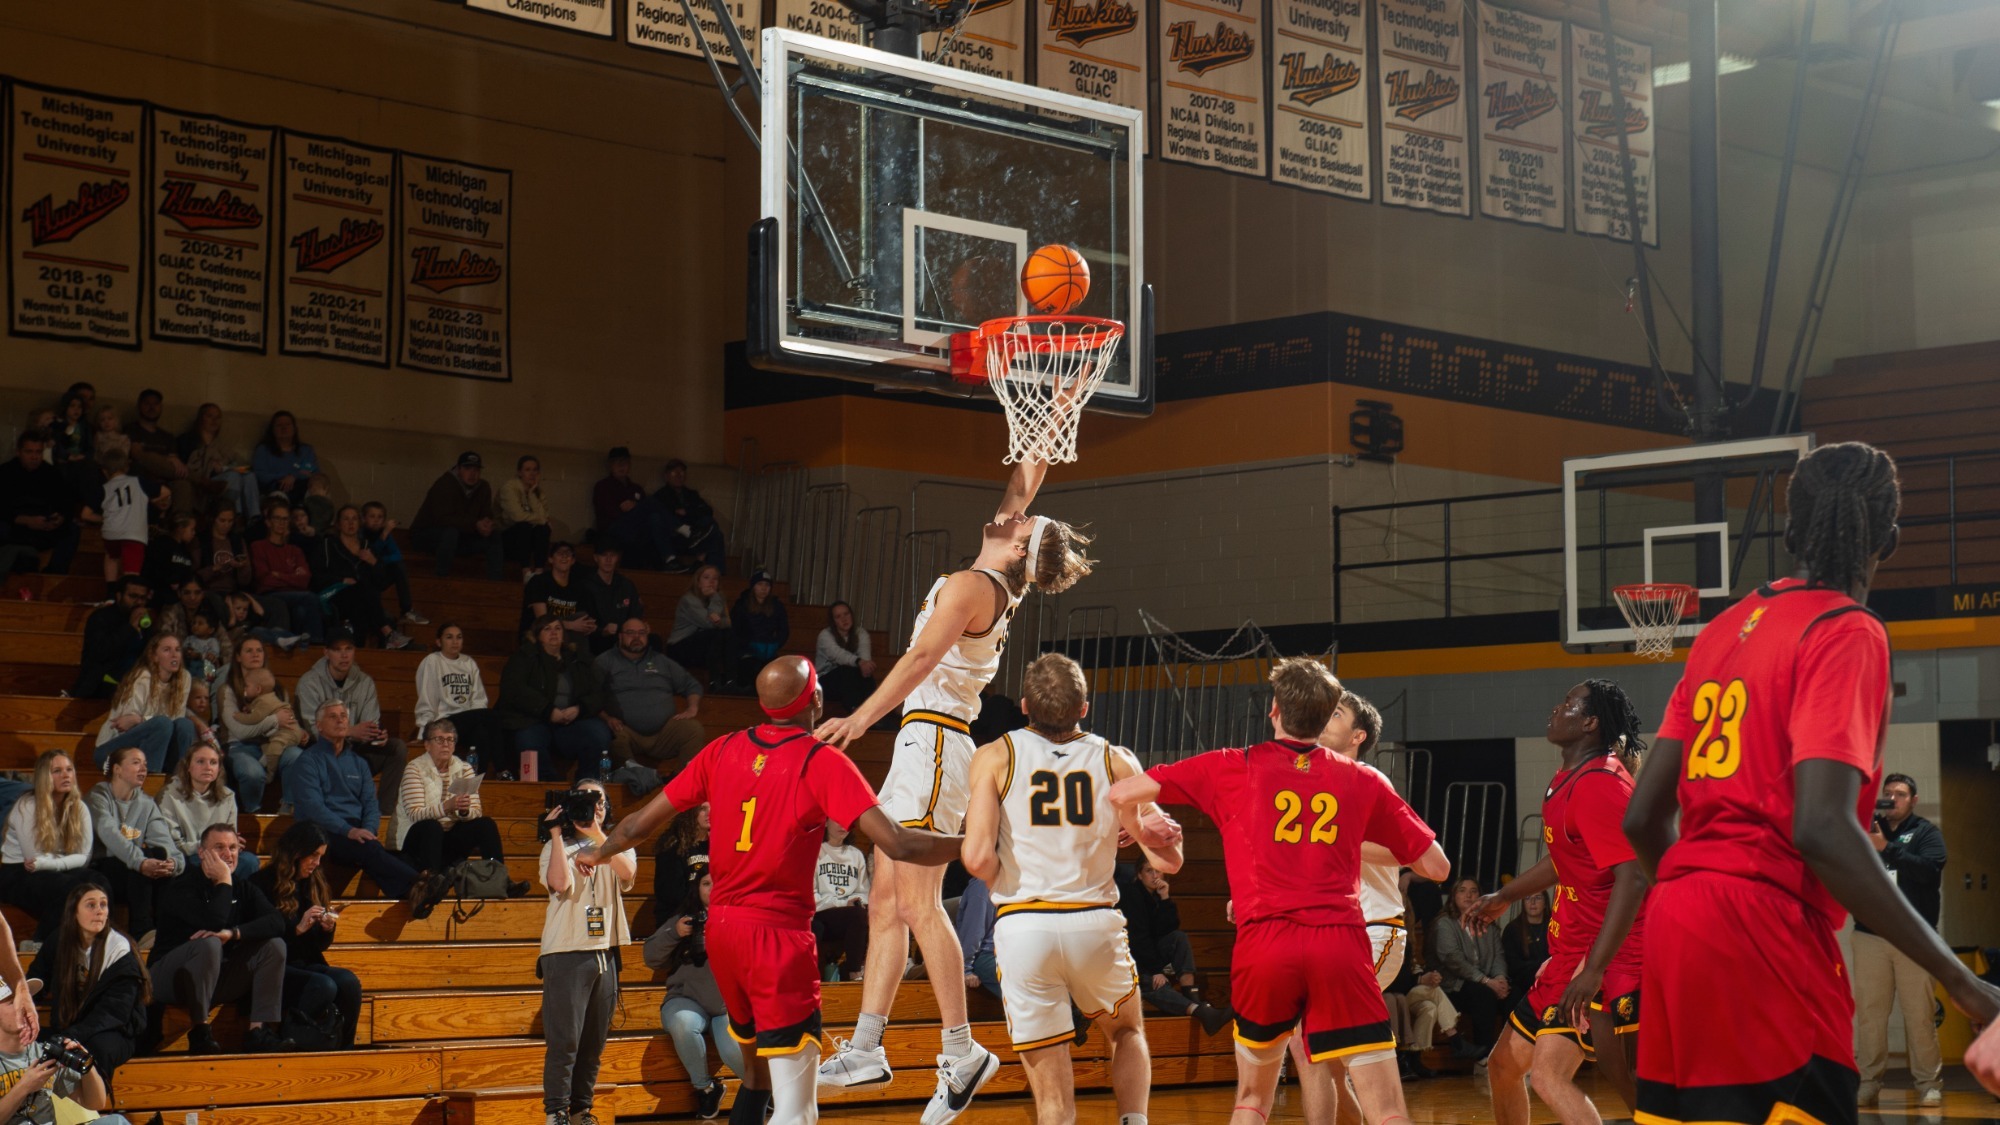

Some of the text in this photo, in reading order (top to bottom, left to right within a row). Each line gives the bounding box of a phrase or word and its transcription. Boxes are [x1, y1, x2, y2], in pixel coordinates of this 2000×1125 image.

[636, 2, 687, 27] Regional
[787, 13, 822, 36] NCAA
[1289, 6, 1350, 42] University
[1380, 3, 1459, 38] Technological
[636, 23, 691, 48] Women's
[1393, 30, 1450, 62] University
[1483, 20, 1556, 50] Technological
[943, 37, 994, 61] 2005-06
[1165, 20, 1255, 77] Huskies
[1069, 60, 1118, 84] 2007-08
[1279, 52, 1361, 107] Huskies
[1075, 78, 1111, 98] GLIAC
[1384, 69, 1460, 122] Huskies
[41, 97, 114, 122] Michigan
[1189, 94, 1235, 115] 2007-08
[21, 110, 135, 144] Technological
[179, 120, 247, 144] Michigan
[1167, 123, 1201, 142] Regional
[1170, 106, 1200, 125] NCAA
[1205, 113, 1244, 134] Division
[1299, 119, 1342, 140] 2008-09
[36, 134, 117, 163] University
[159, 130, 266, 160] Technological
[307, 143, 371, 167] Michigan
[1168, 140, 1258, 170] Women's Basketball
[1305, 136, 1337, 155] GLIAC
[1391, 144, 1416, 161] NCAA
[1418, 149, 1451, 168] Division
[175, 151, 249, 181] University
[288, 157, 389, 187] Technological
[1280, 147, 1363, 177] Women's Basketball
[425, 165, 487, 192] Michigan
[1280, 163, 1299, 178] North
[1326, 174, 1363, 193] Champions
[303, 178, 373, 205] University
[408, 182, 503, 215] Technological
[22, 178, 130, 248] Huskies
[158, 179, 263, 231] Huskies
[422, 207, 490, 238] University
[179, 239, 243, 262] 2020-21
[290, 217, 384, 274] Huskies
[158, 253, 195, 270] GLIAC
[410, 246, 502, 294] Huskies
[47, 284, 106, 304] GLIAC
[158, 285, 196, 302] GLIAC
[175, 272, 247, 295] Champions
[22, 298, 129, 323] Women's Basketball
[175, 303, 246, 325] Champions
[308, 292, 367, 313] 2020-21
[18, 314, 46, 328] North
[159, 319, 209, 335] Women's
[290, 305, 322, 319] NCAA
[328, 309, 371, 329] Division
[428, 306, 483, 326] 2022-23
[409, 318, 441, 335] NCAA
[442, 322, 489, 342] DIVISION
[1345, 325, 1539, 402] HOOP
[115, 485, 132, 507] 11
[1953, 593, 1975, 611] MI
[1688, 679, 1748, 780] 23
[1031, 769, 1094, 829] 20
[735, 796, 758, 852] 1
[1273, 789, 1339, 846] 22
[827, 874, 850, 886] TECH
